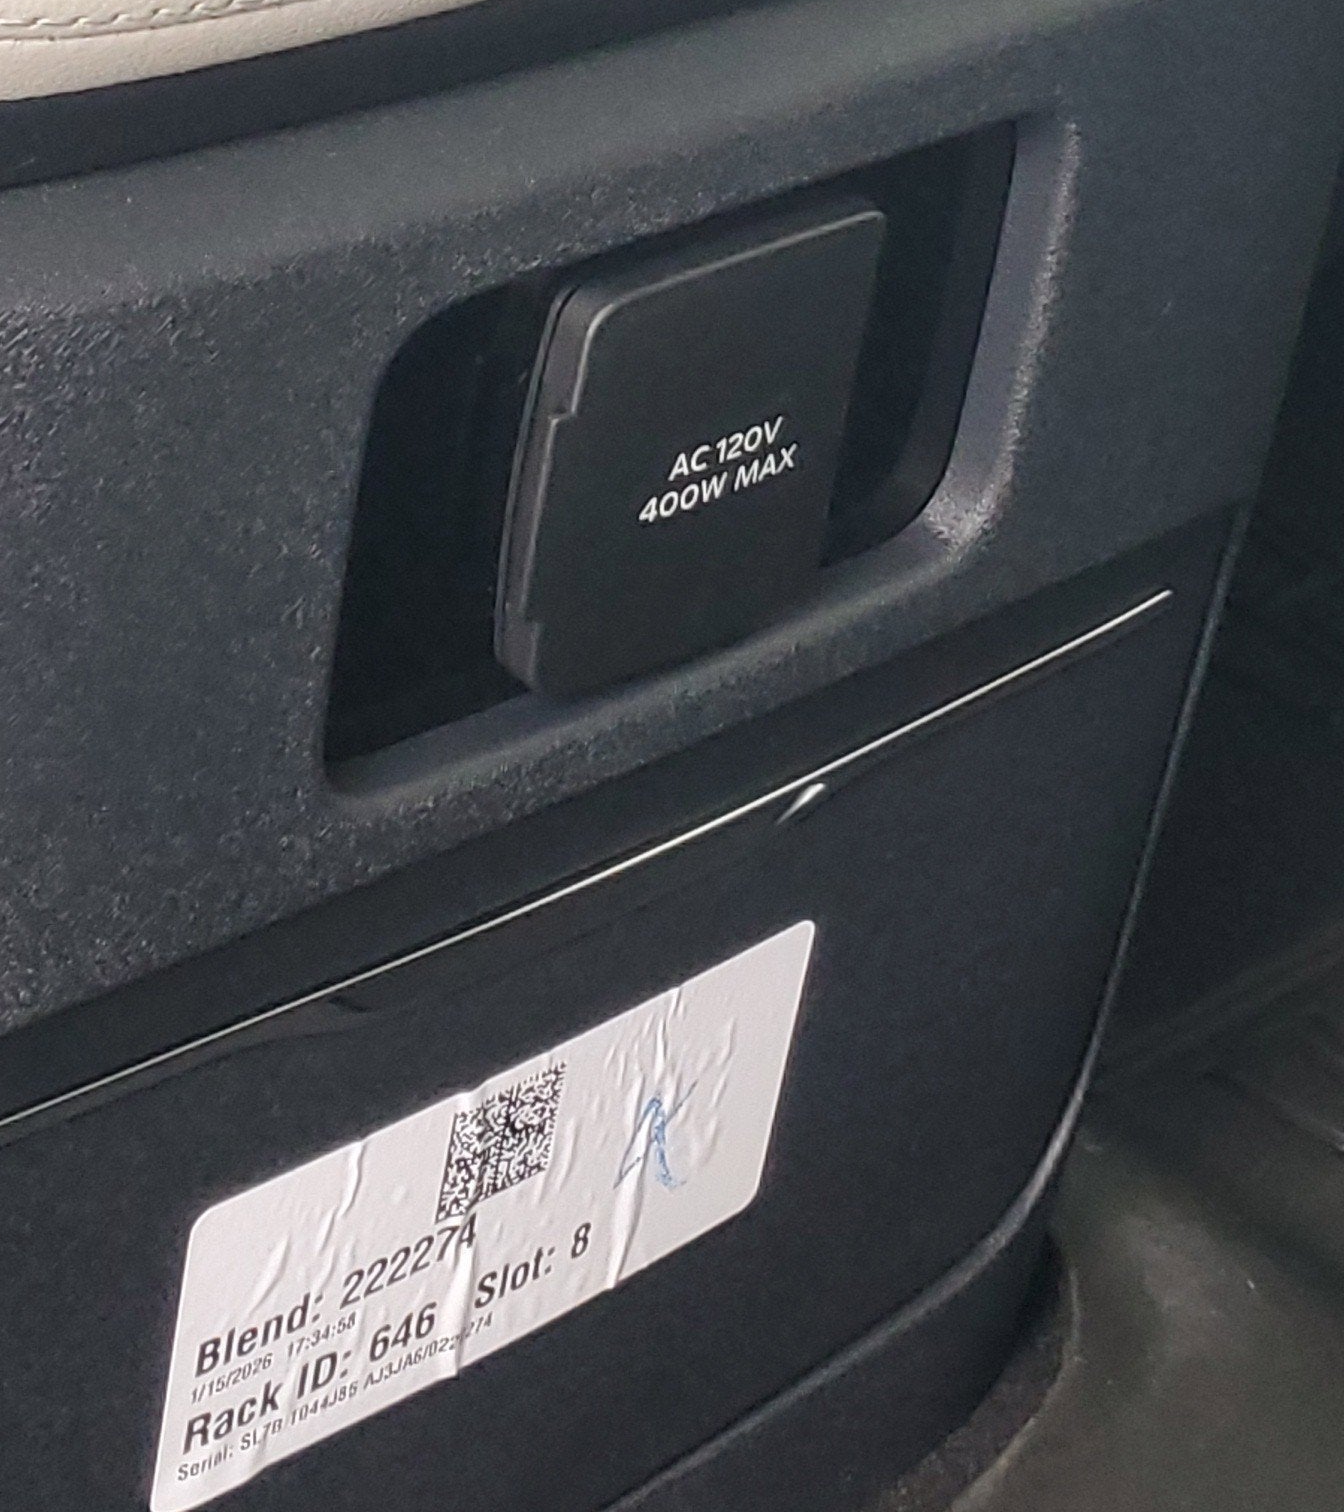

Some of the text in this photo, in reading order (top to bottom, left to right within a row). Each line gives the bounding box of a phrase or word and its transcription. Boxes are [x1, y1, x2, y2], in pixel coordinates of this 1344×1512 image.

[638, 443, 798, 523] 400W MAX
[668, 416, 784, 481] AC 120V
[195, 1212, 476, 1377] Blend: 222274
[183, 1222, 591, 1455] Rack ID: 646 Slot: 8
[177, 1445, 234, 1482] Serial:
